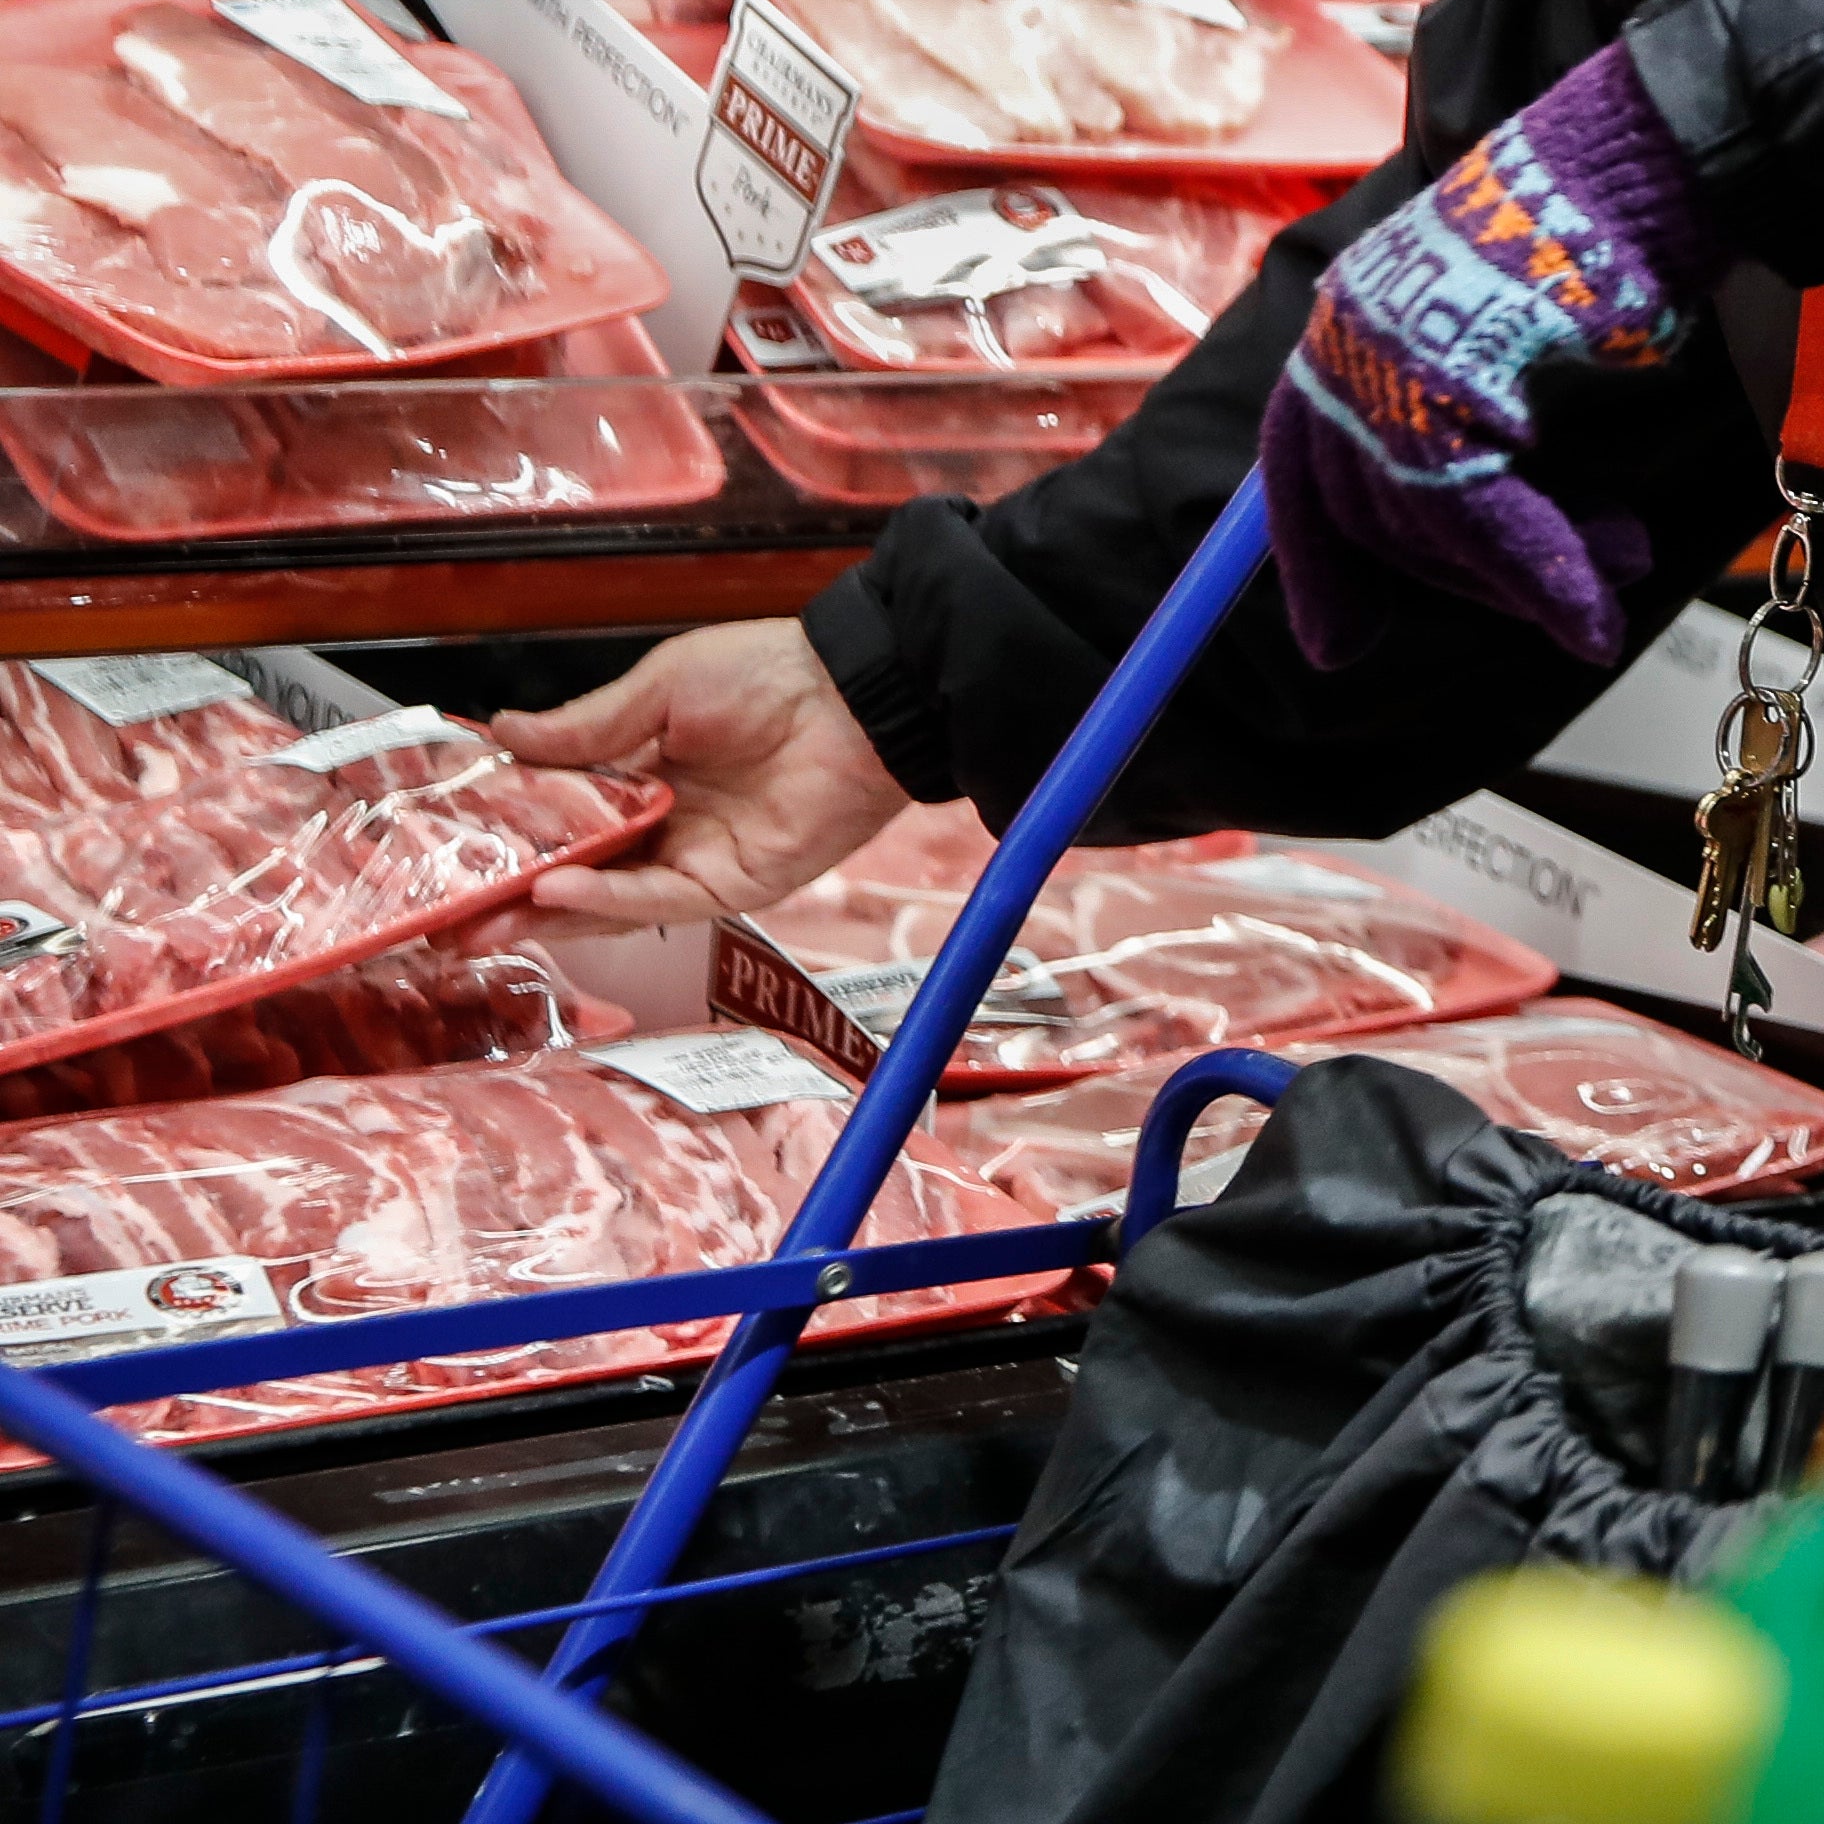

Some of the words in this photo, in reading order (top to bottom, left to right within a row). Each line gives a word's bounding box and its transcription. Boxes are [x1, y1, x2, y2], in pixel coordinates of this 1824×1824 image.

[725, 83, 820, 191] PRIME
[731, 162, 771, 219] Pork
[727, 945, 867, 1067] PRIME
[59, 1306, 134, 1328] PORK
